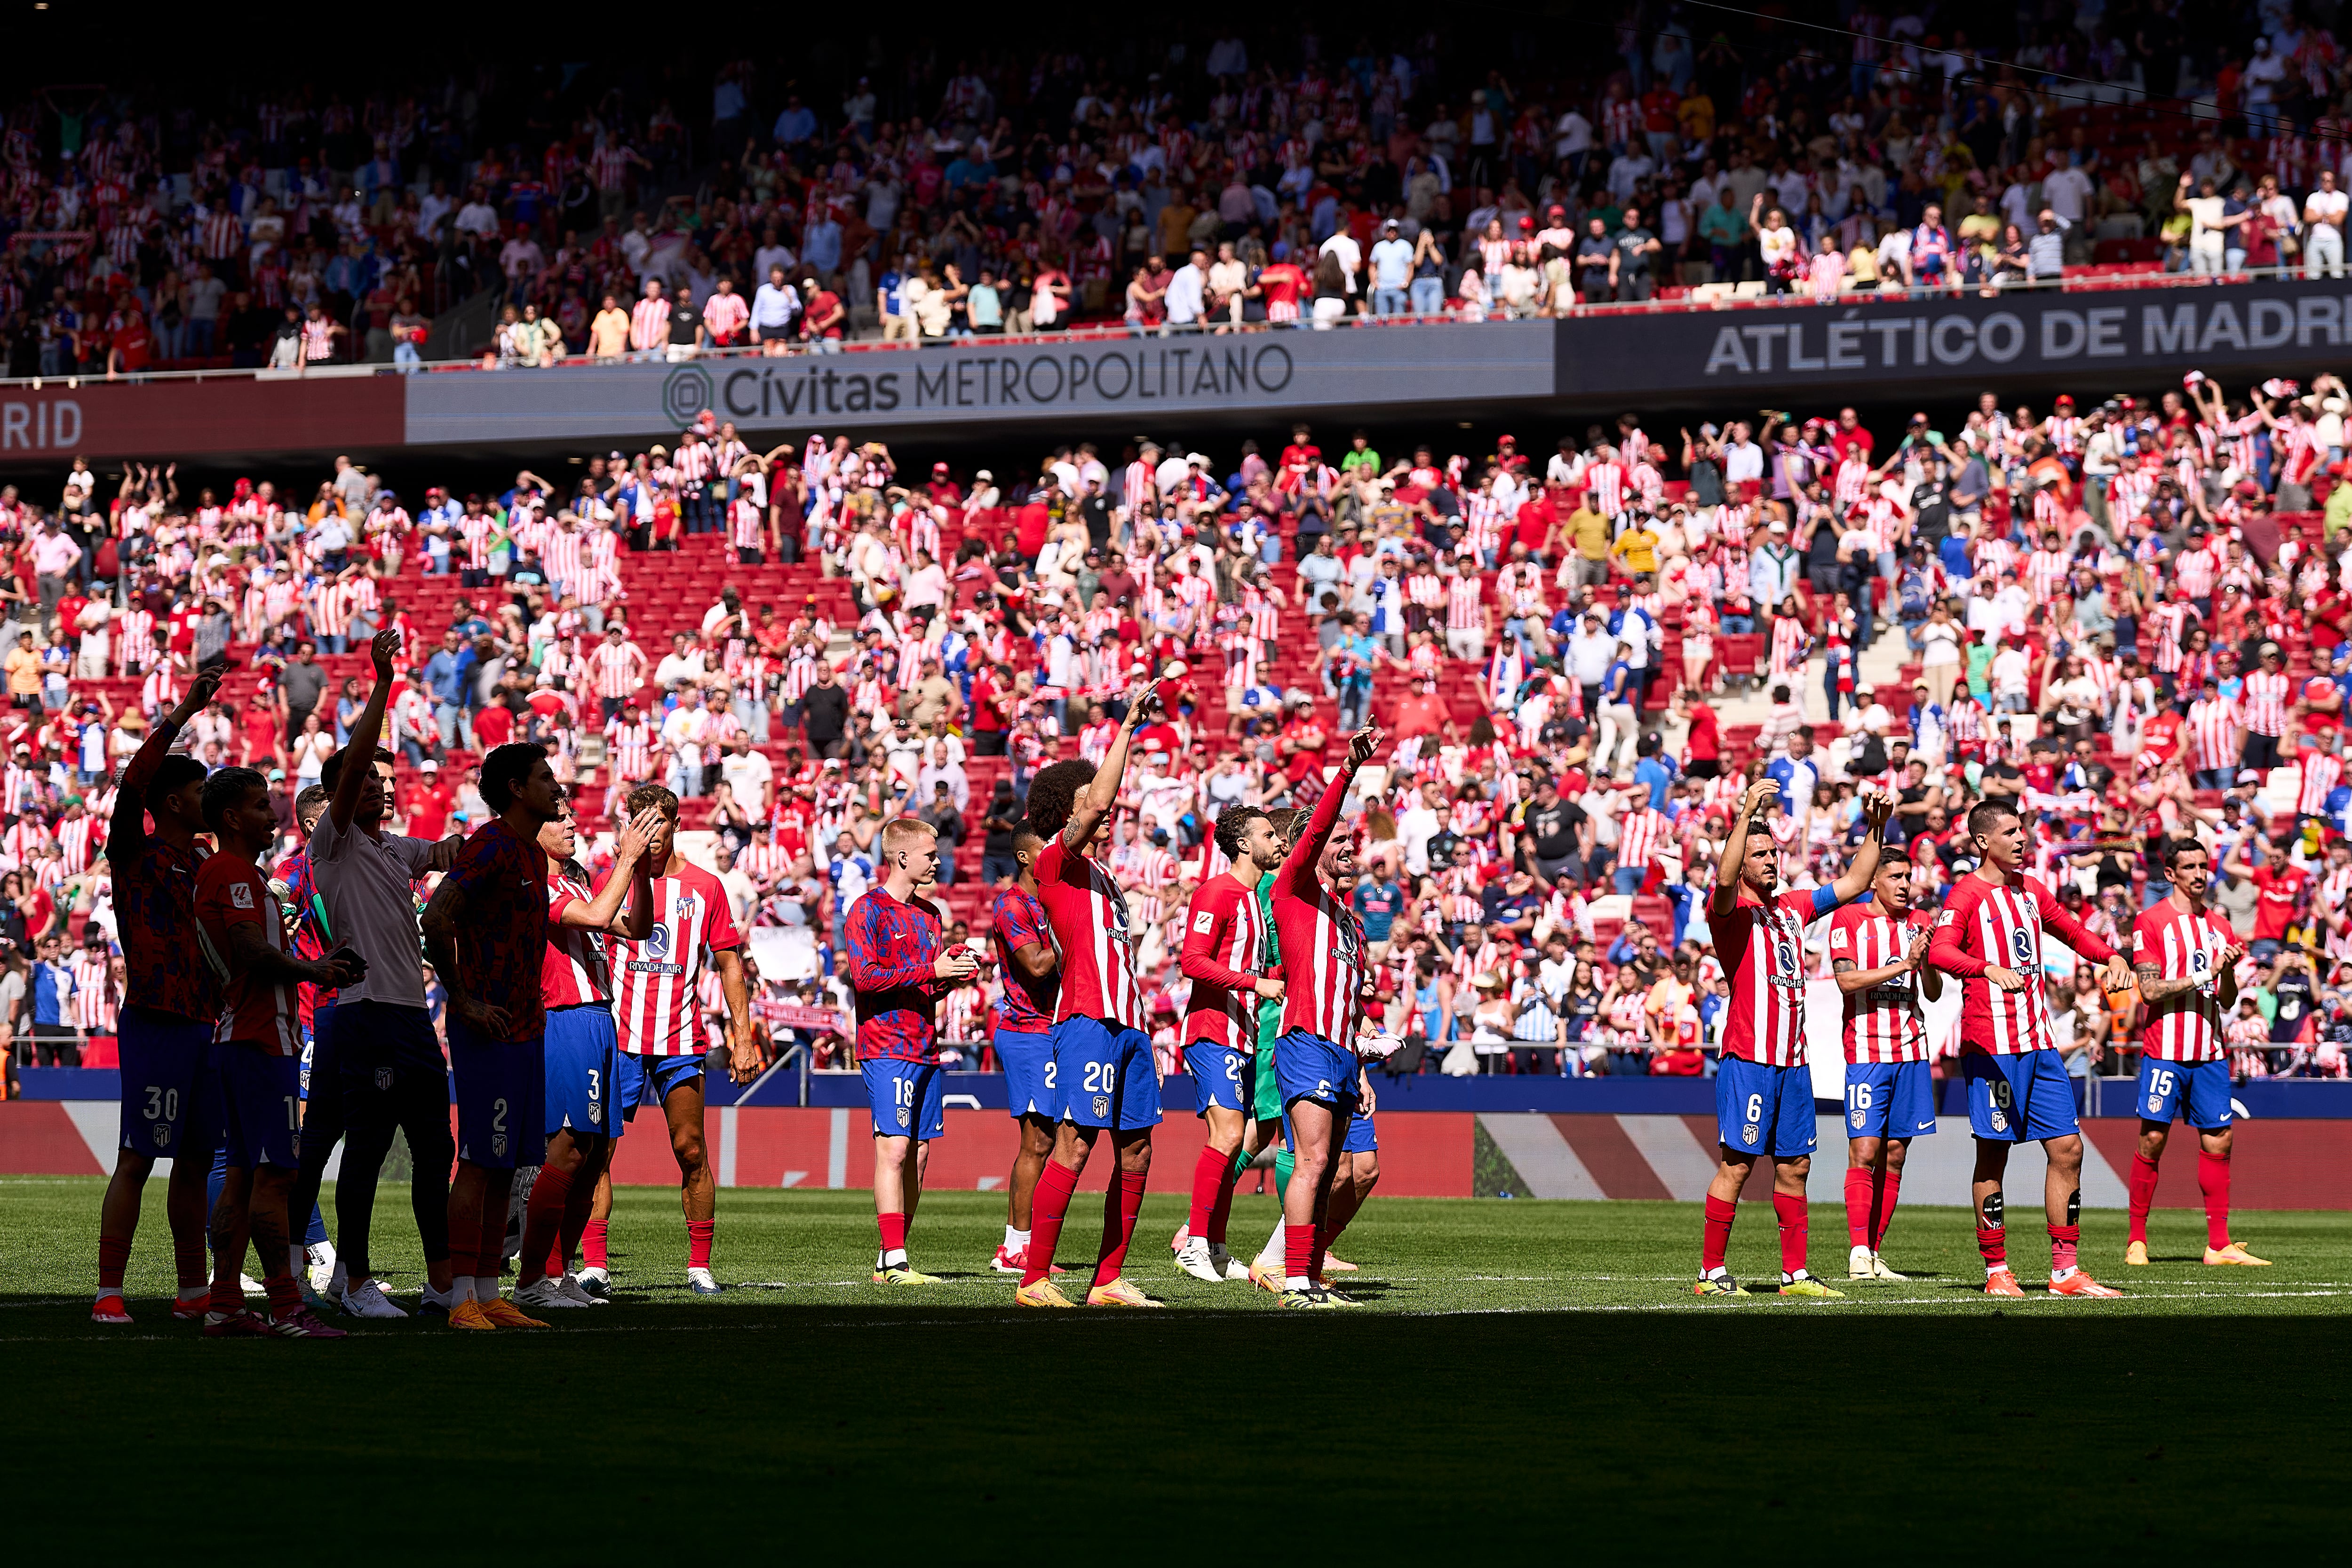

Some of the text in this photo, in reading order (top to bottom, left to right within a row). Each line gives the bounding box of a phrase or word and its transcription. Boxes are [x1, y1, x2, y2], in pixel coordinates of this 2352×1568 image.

[1705, 309, 2025, 375] ATLÉTICO
[2041, 307, 2126, 360] DE
[723, 344, 1292, 416] Cívitas METROPOLITANO
[4, 400, 82, 449] RID
[629, 962, 682, 974] RIYADH AIR
[1771, 975, 1796, 988] RIYADH
[1871, 991, 1900, 1000] RIYADH
[301, 1041, 314, 1068] 4
[588, 1069, 599, 1100] 3
[1083, 1061, 1114, 1093] 20
[2149, 1068, 2174, 1096] 15
[143, 1086, 178, 1121] 30
[892, 1077, 914, 1112] 18
[1747, 1093, 1763, 1122] 6
[1848, 1083, 1872, 1110] 16
[1986, 1080, 2010, 1108] 19
[493, 1099, 507, 1131] 2
